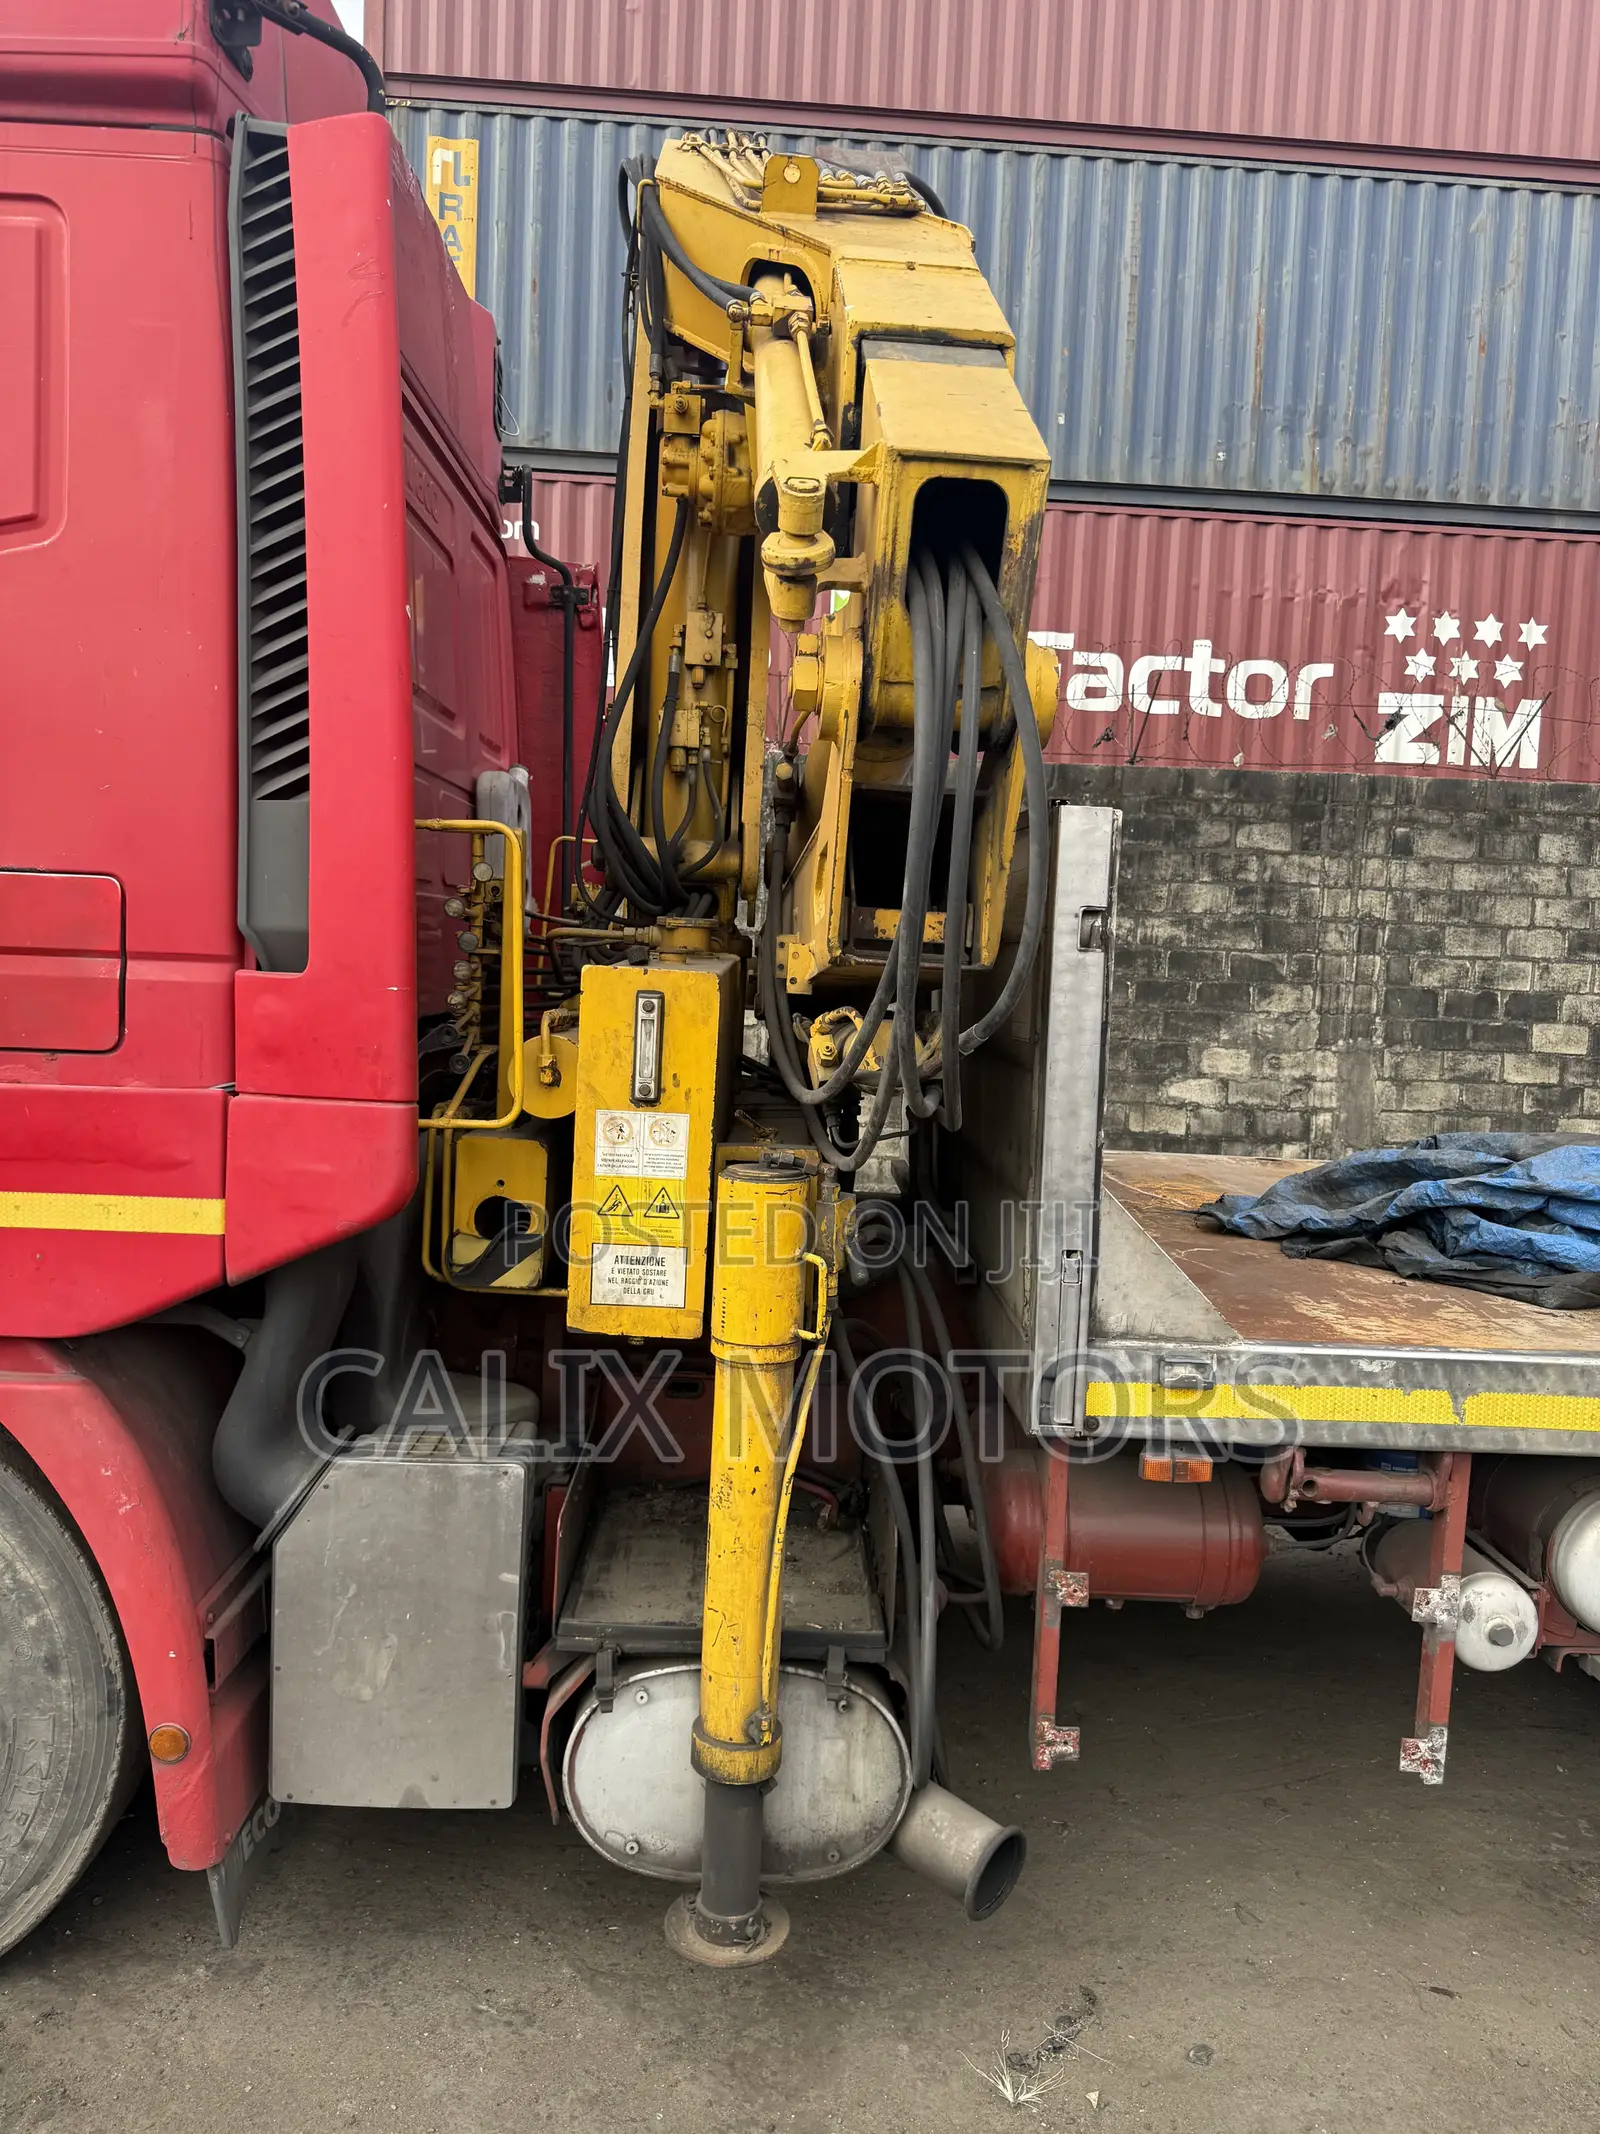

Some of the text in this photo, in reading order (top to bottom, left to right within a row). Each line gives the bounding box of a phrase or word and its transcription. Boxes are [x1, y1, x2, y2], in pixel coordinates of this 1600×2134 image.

[1374, 692, 1544, 769] ZIM
[613, 1254, 667, 1267] ATTENZIONE
[617, 1267, 640, 1276] VIETATO
[641, 1268, 667, 1277] SOSTARE
[607, 1277, 619, 1285] NEL
[620, 1277, 641, 1285] RAGGIO
[622, 1287, 641, 1295] DELLA
